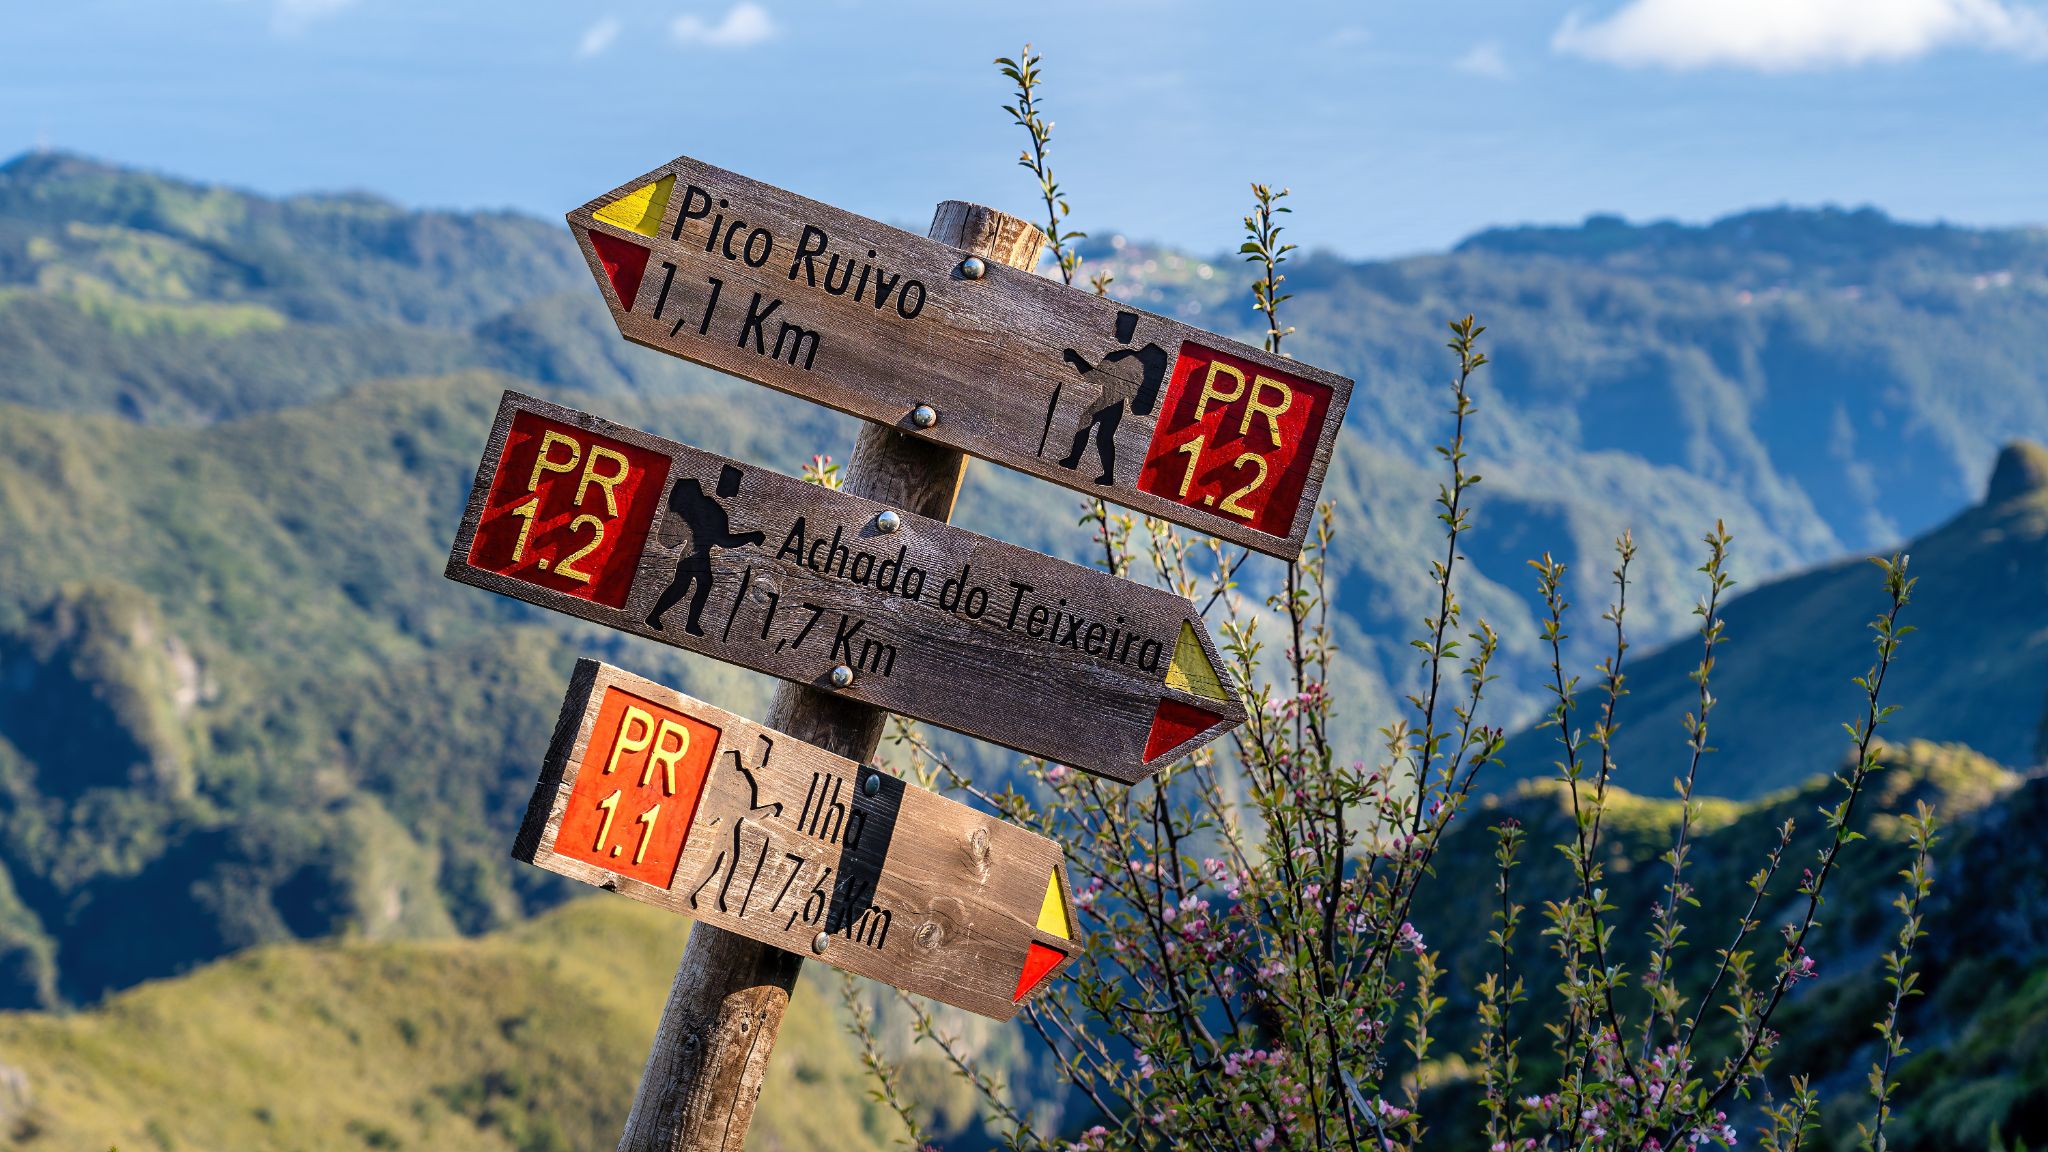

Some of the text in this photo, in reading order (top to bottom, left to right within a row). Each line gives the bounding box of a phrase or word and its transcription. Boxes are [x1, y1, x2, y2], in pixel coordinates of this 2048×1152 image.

[671, 185, 926, 319] Pico Ruivo
[653, 262, 820, 371] 1,1 Km
[1194, 360, 1293, 449] PR
[528, 430, 629, 517] PR
[1179, 435, 1268, 519] 1.2
[512, 497, 604, 584] 1.2
[760, 591, 897, 677] 1,7 Km
[776, 517, 1163, 673] Achada do Teixeira
[608, 705, 690, 796] PR
[594, 789, 661, 864] 1.1
[797, 772, 868, 851] Ilha
[771, 852, 892, 950] 7,6 Km
